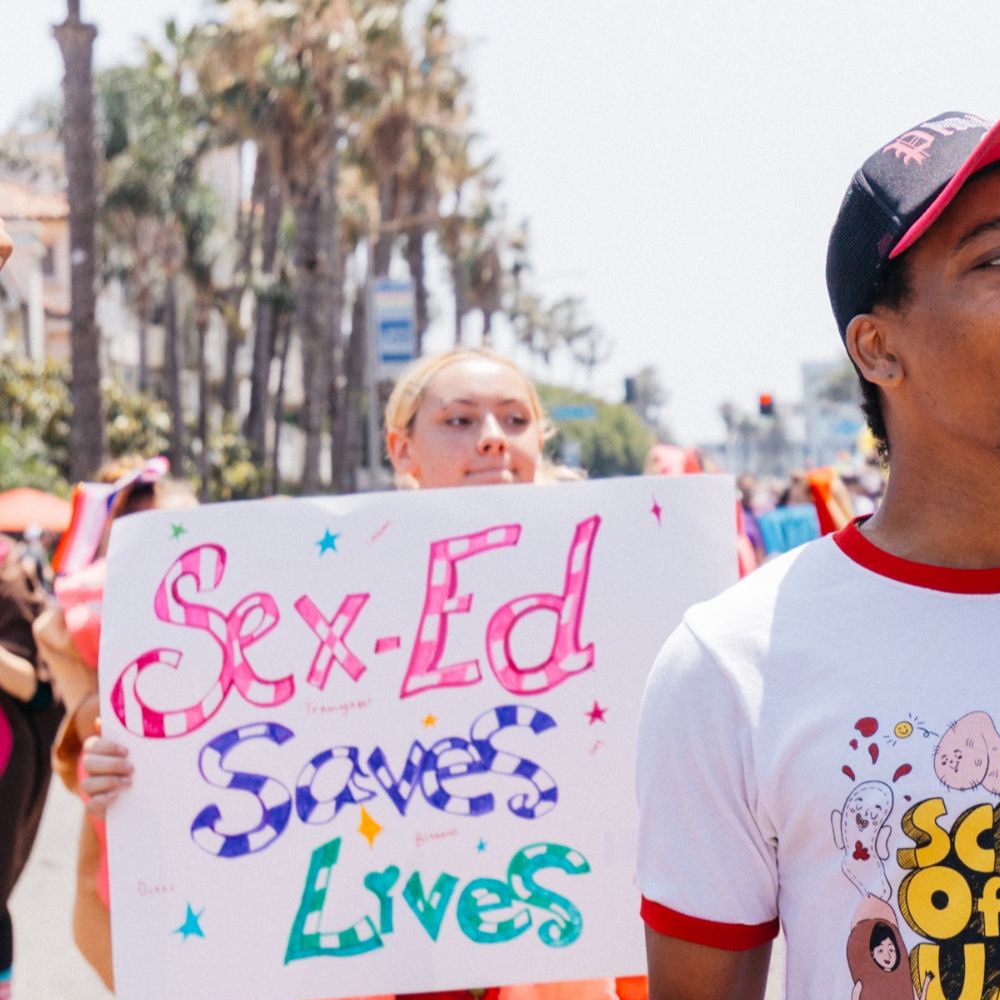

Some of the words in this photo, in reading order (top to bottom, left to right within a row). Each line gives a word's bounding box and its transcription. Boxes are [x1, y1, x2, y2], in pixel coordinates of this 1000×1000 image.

[110, 514, 601, 739] Sex-Ed
[190, 704, 558, 858] Saves
[285, 837, 591, 966] Lives
